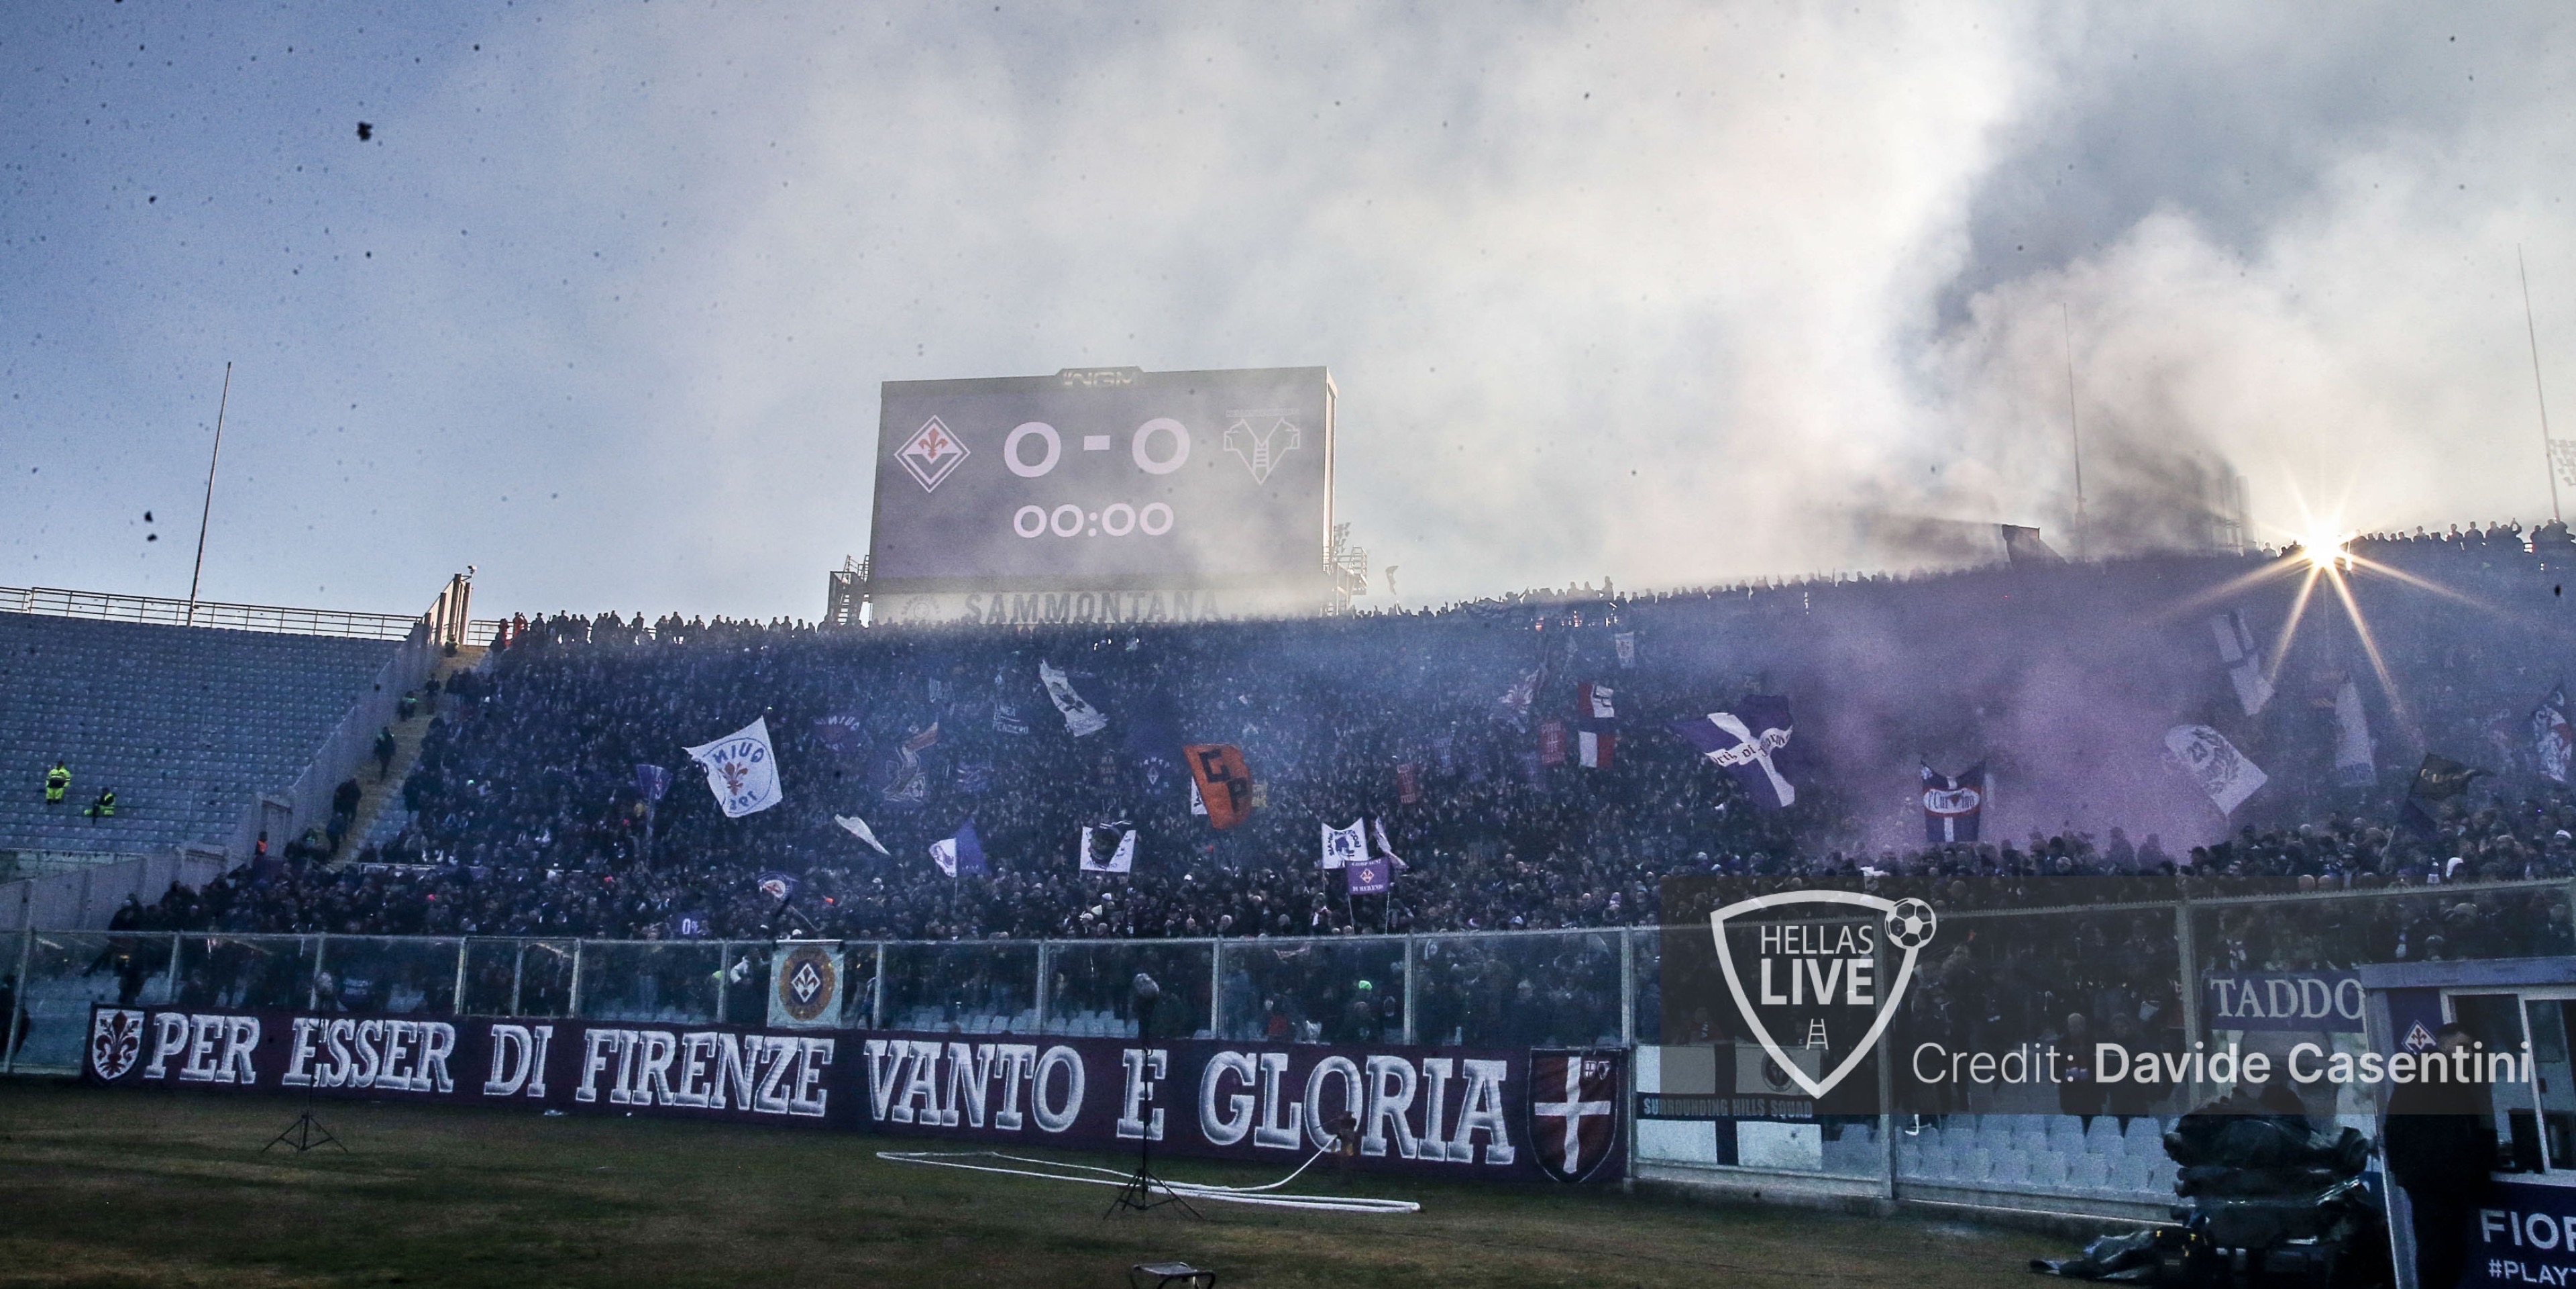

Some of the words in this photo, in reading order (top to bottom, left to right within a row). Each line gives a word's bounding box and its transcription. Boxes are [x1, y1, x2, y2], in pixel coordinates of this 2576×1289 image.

[1004, 421, 1061, 478] 0
[1131, 417, 1191, 474] 0
[1013, 501, 1174, 539] 00:00
[965, 592, 1222, 624] SAMMONTANA
[144, 1011, 262, 1085] PER
[282, 1016, 456, 1094] ESSER
[483, 1023, 553, 1098] DI
[575, 1028, 835, 1118] FIRENZE
[863, 1039, 1086, 1134] VANTO
[1116, 1048, 1168, 1141] E
[1198, 1049, 1515, 1166] GLORIA
[1644, 1097, 1729, 1115] SURROUNDING
[1732, 1098, 1766, 1116] HILLS
[1770, 1099, 1813, 1119] SQUAD
[2487, 1258, 2576, 1287] #PLAY
